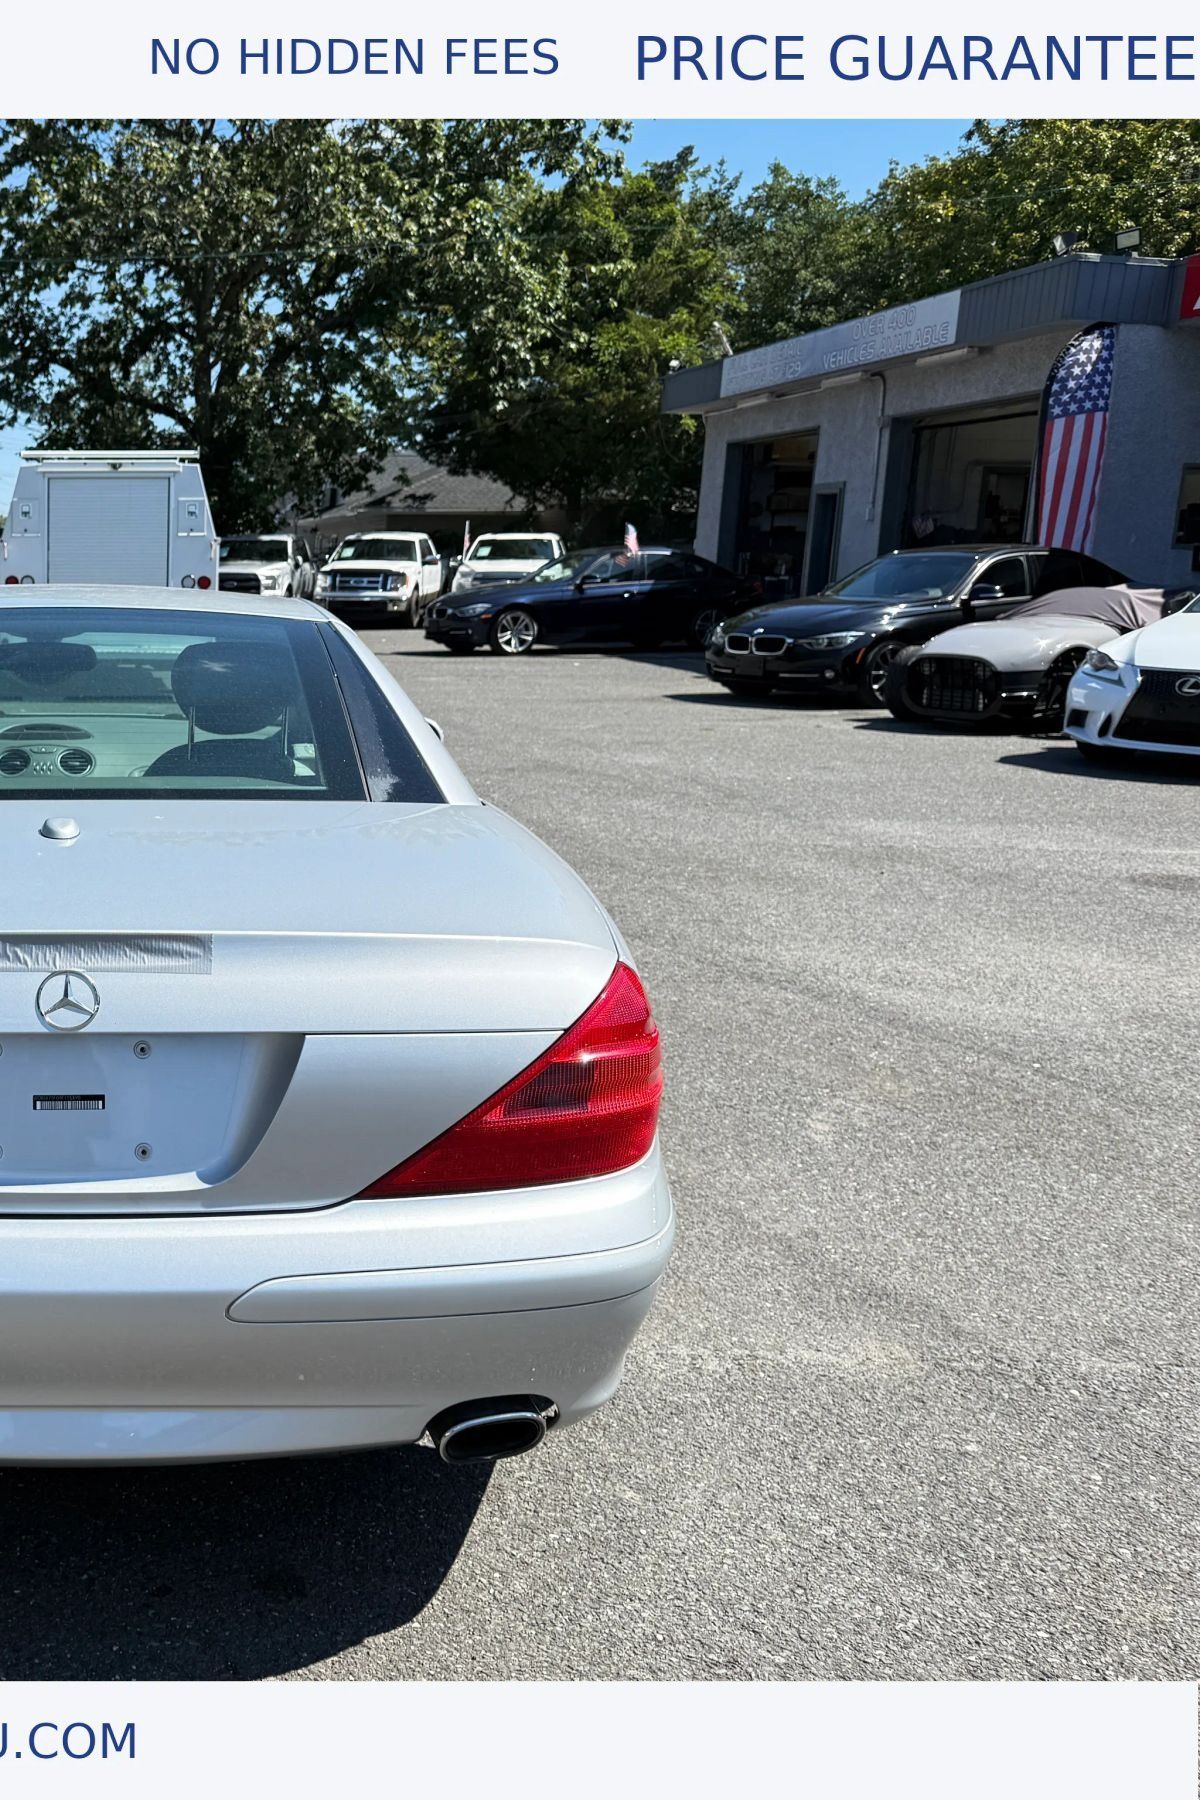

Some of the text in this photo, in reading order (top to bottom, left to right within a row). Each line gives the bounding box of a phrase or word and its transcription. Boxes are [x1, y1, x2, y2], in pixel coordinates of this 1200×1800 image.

[852, 305, 917, 341] OVER 400
[822, 320, 950, 370] VEHICLES AVAILABLE
